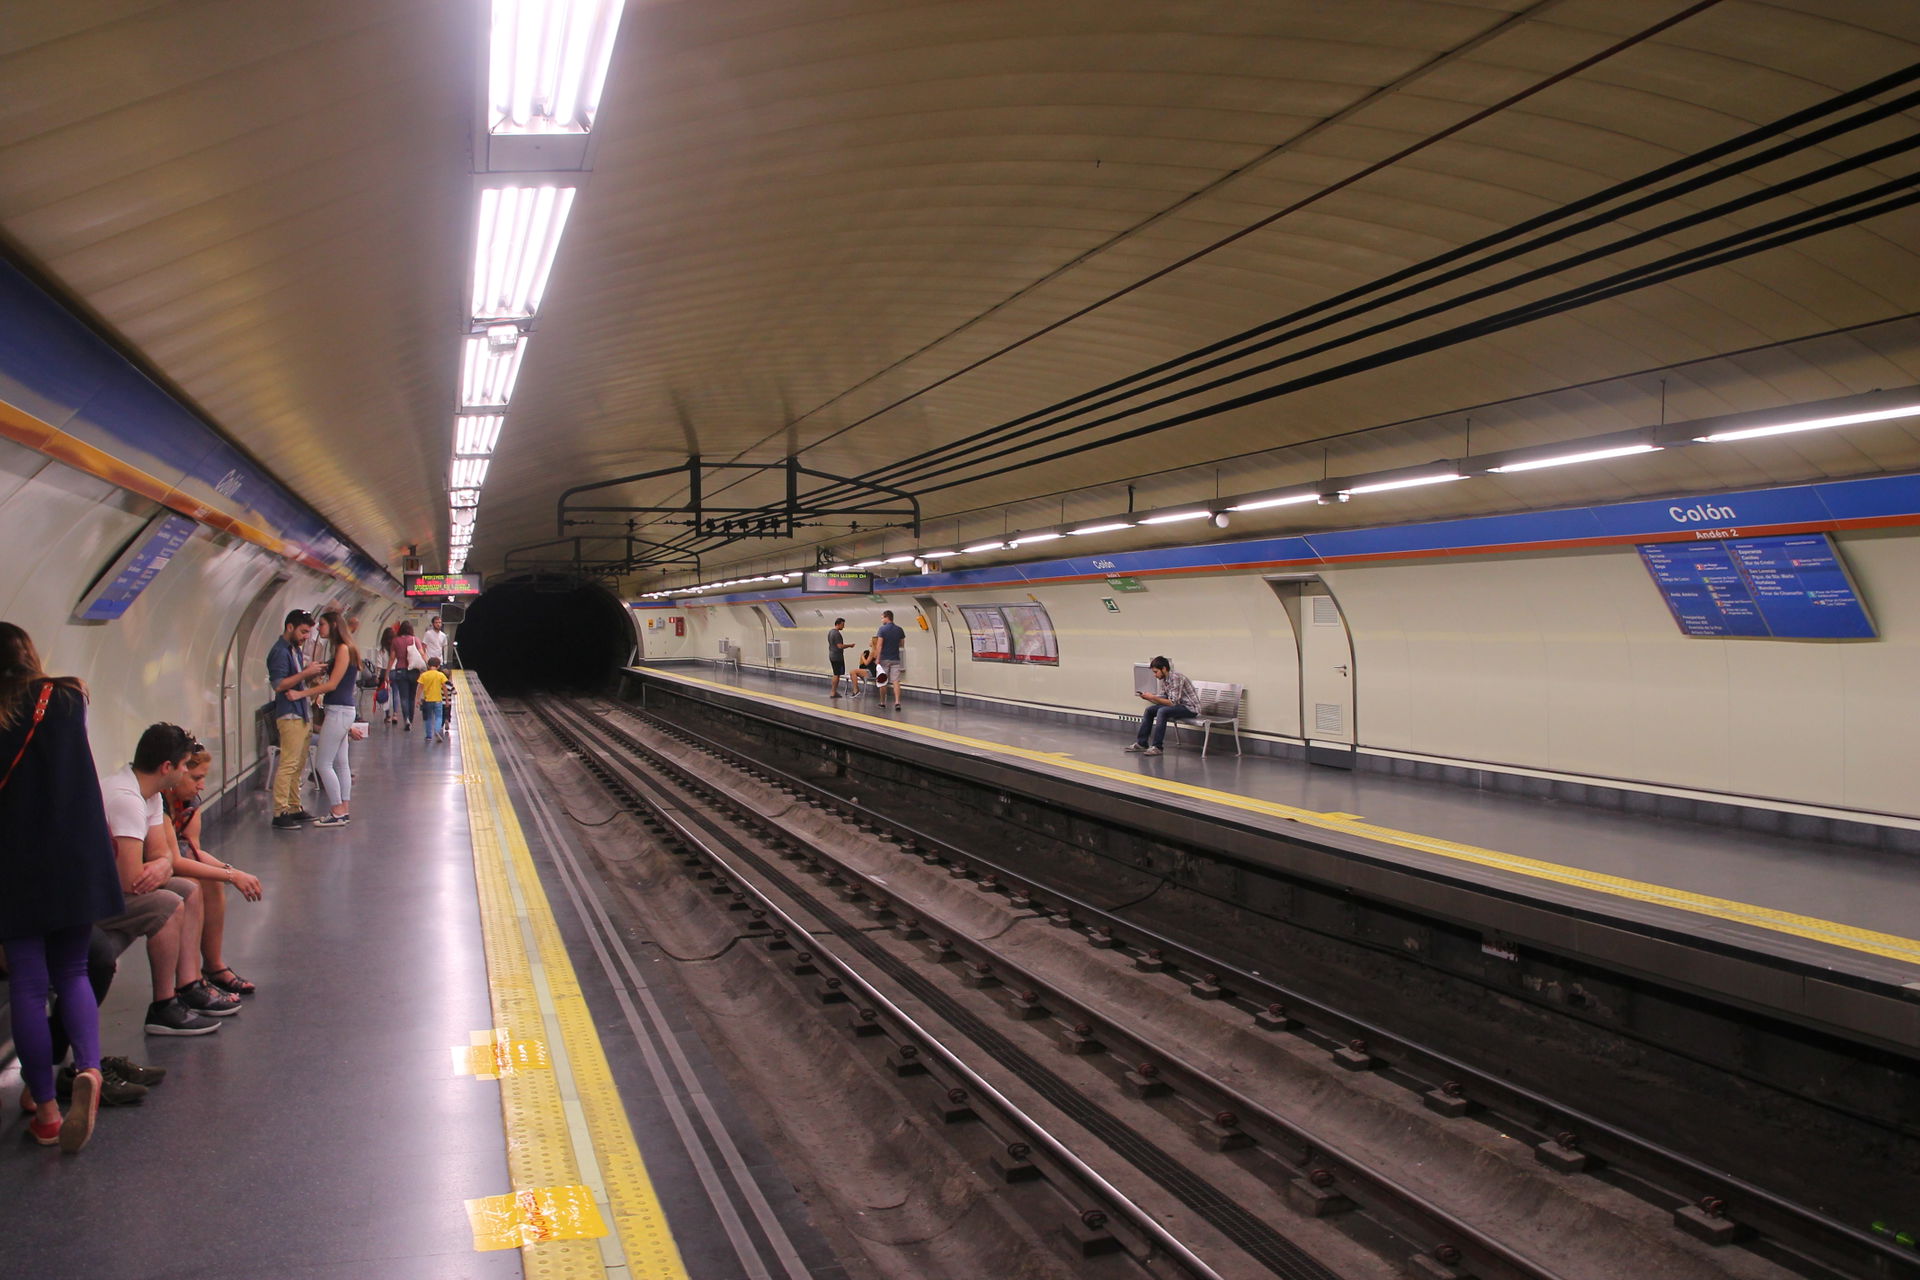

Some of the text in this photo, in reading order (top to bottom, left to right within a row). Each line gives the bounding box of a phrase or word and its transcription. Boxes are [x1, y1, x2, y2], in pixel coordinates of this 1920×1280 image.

[1669, 504, 1736, 522] Colón
[1696, 528, 1739, 540] Andén 2
[1092, 560, 1116, 569] Colón
